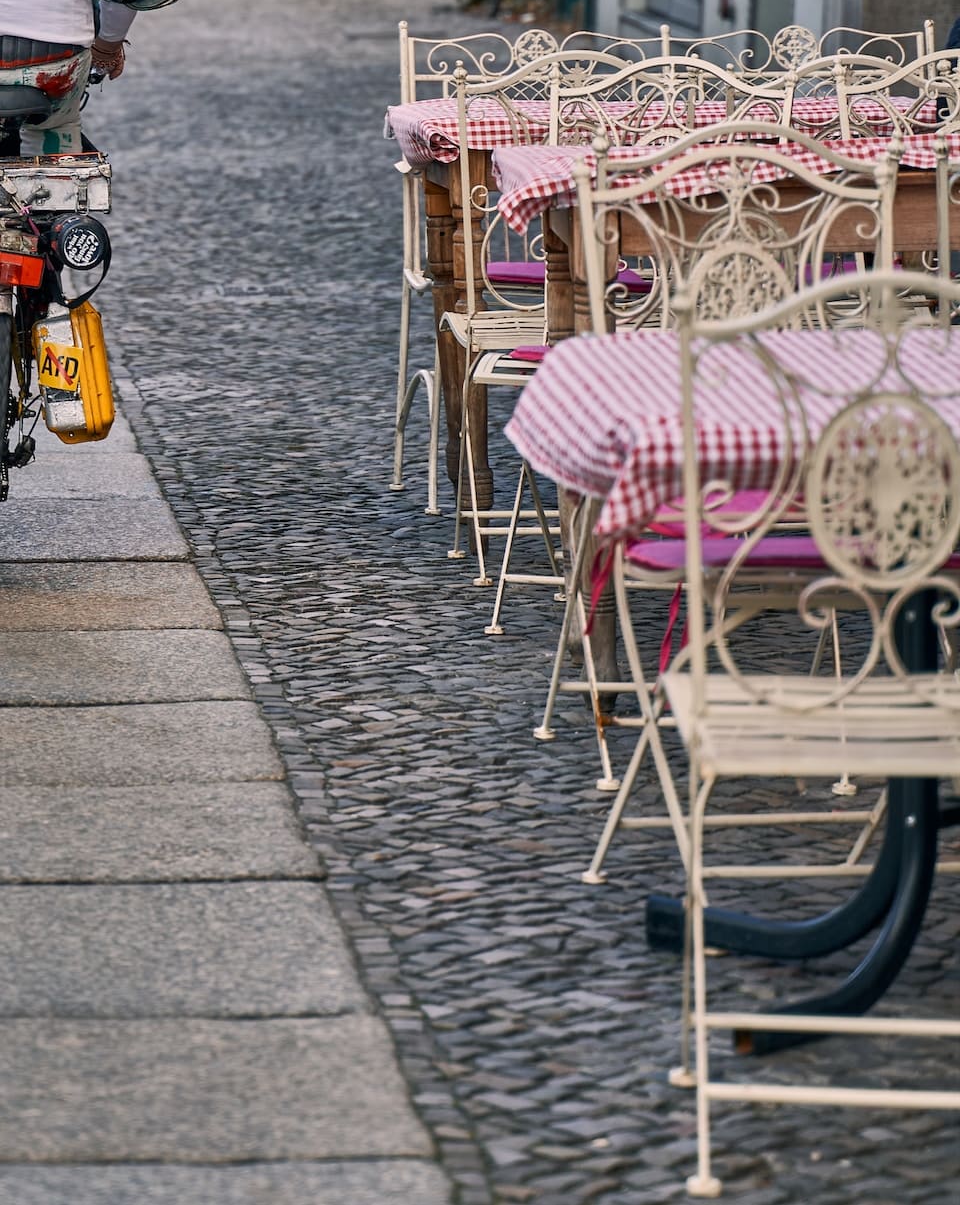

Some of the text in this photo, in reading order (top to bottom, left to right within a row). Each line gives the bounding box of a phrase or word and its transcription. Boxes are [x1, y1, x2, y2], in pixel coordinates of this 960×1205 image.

[69, 234, 87, 258] do you
[41, 353, 79, 379] AfD
